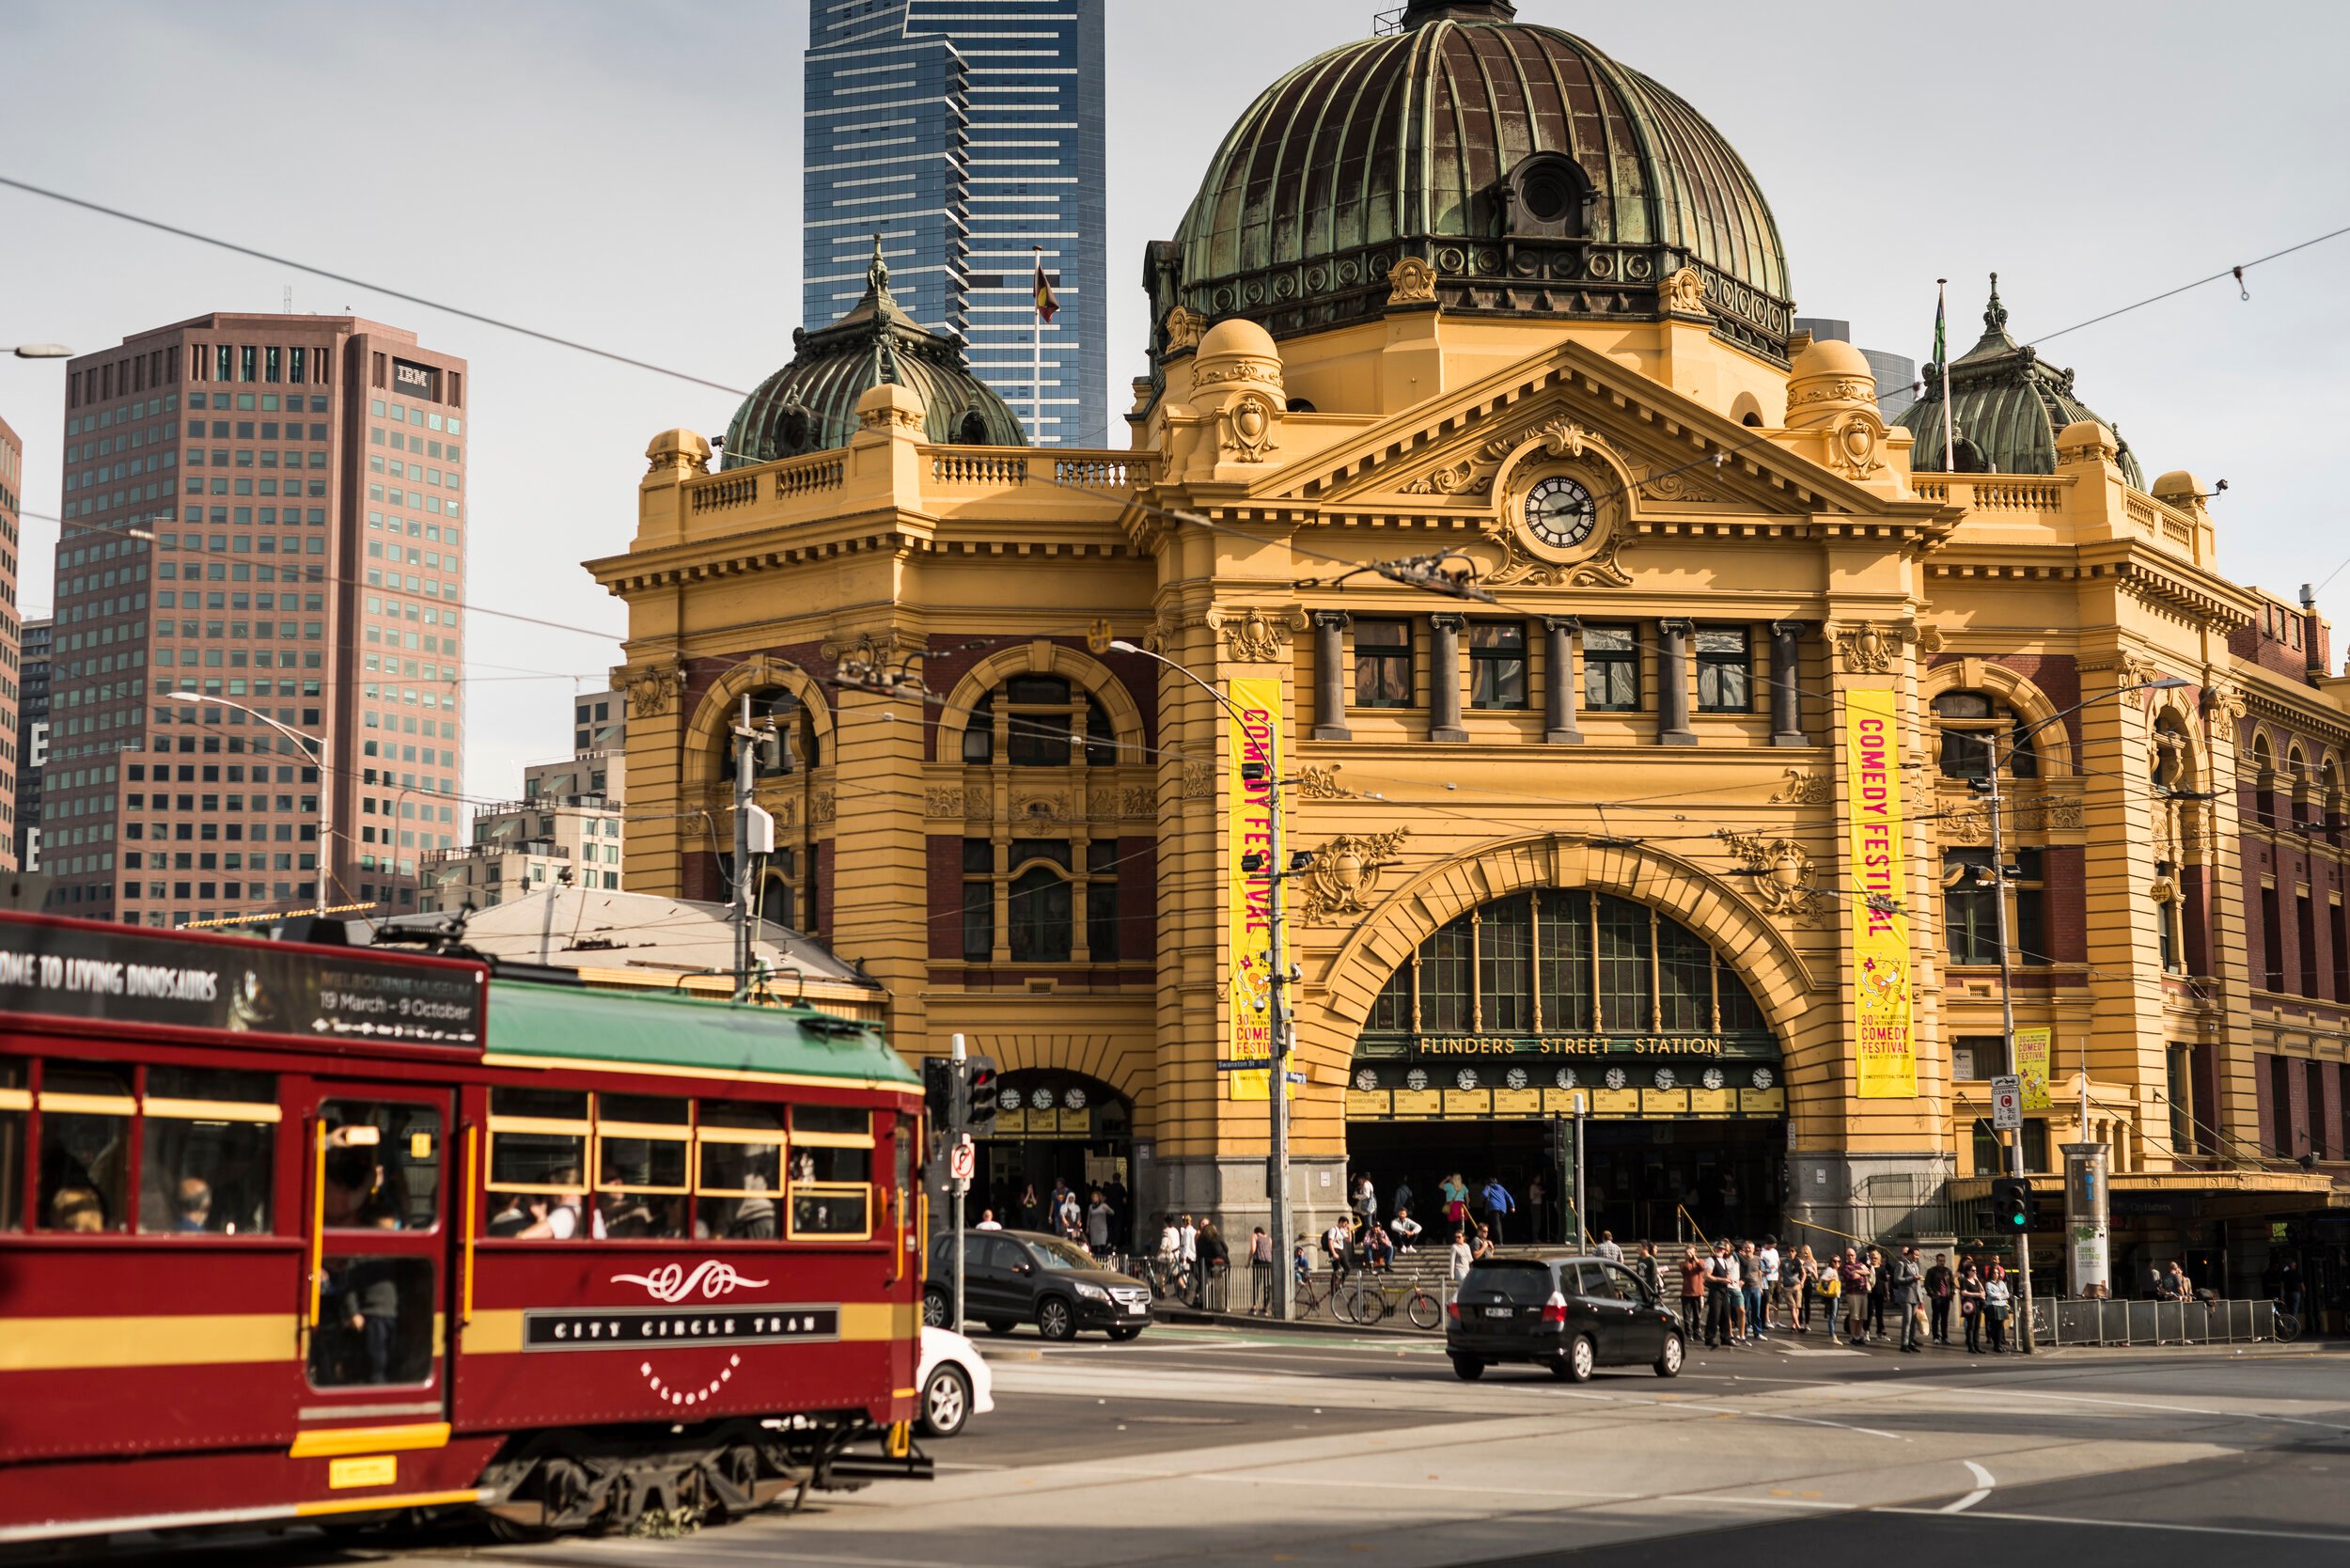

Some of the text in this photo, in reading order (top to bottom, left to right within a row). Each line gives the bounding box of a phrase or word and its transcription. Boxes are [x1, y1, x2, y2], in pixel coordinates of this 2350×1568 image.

[398, 365, 428, 387] IBM
[1243, 709, 1271, 808] COMDY
[1859, 719, 1892, 937] COMEDY FESTIAL
[39, 955, 63, 990] TO
[66, 958, 123, 995] LIVING
[127, 964, 218, 1002] DINOSAURS
[320, 971, 472, 998] MELBOURNE MUSEUM
[320, 991, 337, 1010] 19
[339, 992, 388, 1014] March
[399, 997, 410, 1016] 9
[411, 998, 472, 1021] October
[1237, 1014, 1248, 1026] 30
[1861, 1015, 1872, 1026] 30
[1861, 1027, 1908, 1041] COMEDY
[1420, 1038, 1722, 1055] FLINDERS STREET STATION
[1862, 1043, 1909, 1054] FESTIVAL
[2018, 1043, 2045, 1052] COMEDY
[2018, 1052, 2045, 1060] FESTIVAL
[2002, 1096, 2012, 1107] C
[555, 1315, 816, 1340] CITY CIRCLE TRAM
